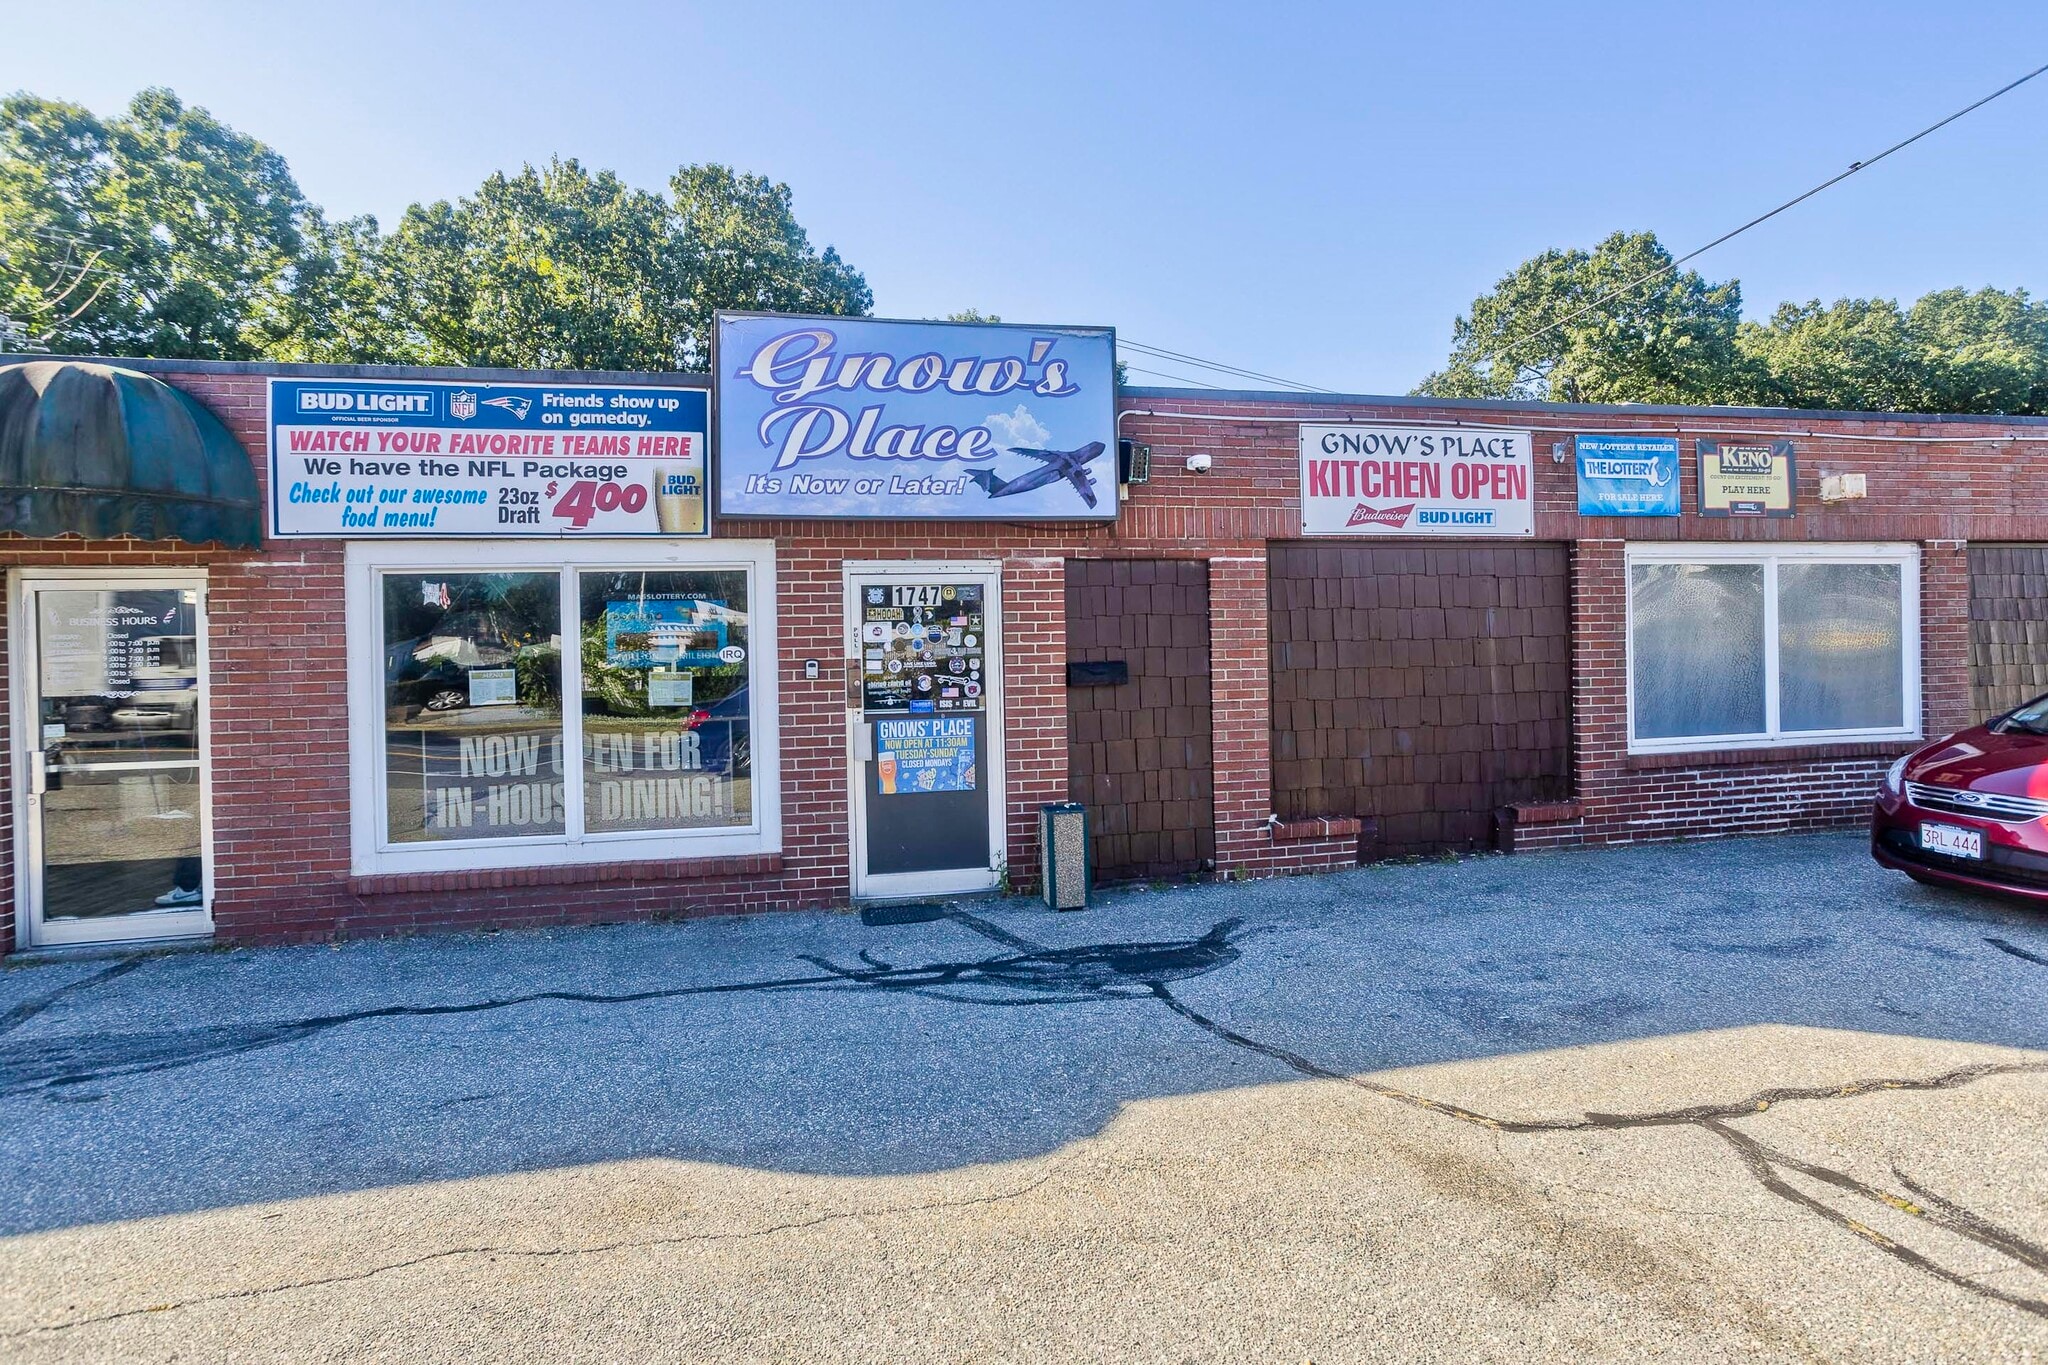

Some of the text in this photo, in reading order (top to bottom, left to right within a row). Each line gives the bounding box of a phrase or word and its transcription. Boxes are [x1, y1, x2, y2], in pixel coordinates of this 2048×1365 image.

[736, 328, 1080, 404] Gnow's
[301, 392, 353, 410] BUD
[454, 403, 474, 415] NFL
[542, 393, 680, 412] Friends show up
[541, 411, 651, 427] on gameday.
[290, 430, 692, 456] WATCH YOUR FAVORITE TEAMS HERE
[758, 402, 998, 472] Place
[1321, 432, 1516, 458] GNOW'S PLACE
[1579, 442, 1675, 452] NEW LOTTERY RETAILER
[304, 458, 628, 481] We have the NFL Package
[1587, 461, 1654, 475] THE LOTTERY
[668, 475, 696, 484] BUD
[745, 473, 967, 495] Its Now or Later!
[1308, 459, 1527, 500] KITCHEN OPEN
[289, 481, 488, 505] Check out our awesome
[498, 487, 540, 505] 23oz
[662, 485, 701, 495] LIGHT
[1598, 493, 1616, 501] FOR
[1618, 493, 1638, 501] SALE
[1722, 485, 1771, 494] PLAY HERE
[342, 505, 438, 527] food menu!
[498, 506, 540, 524] Draft
[1351, 507, 1410, 522] Budweiser
[1419, 511, 1494, 524] BUD LIGHT
[895, 586, 940, 605] 1747
[69, 616, 158, 626] BUSINESS HOURS
[876, 608, 904, 619] HOOAH!
[722, 649, 742, 659] IRQ
[940, 700, 953, 708] ISIS
[880, 719, 972, 738] GNOWS' PLACE
[885, 737, 968, 750] NOW OPEN AT 11:30AM
[460, 735, 540, 778] NOW
[644, 730, 701, 771] FOR
[895, 748, 959, 760] TUESDAY-SUNDAY
[901, 760, 924, 768] CLOSED
[924, 758, 952, 767] MONDAYS
[601, 776, 723, 820] DINING!
[1923, 829, 1979, 853] 3RL 444
